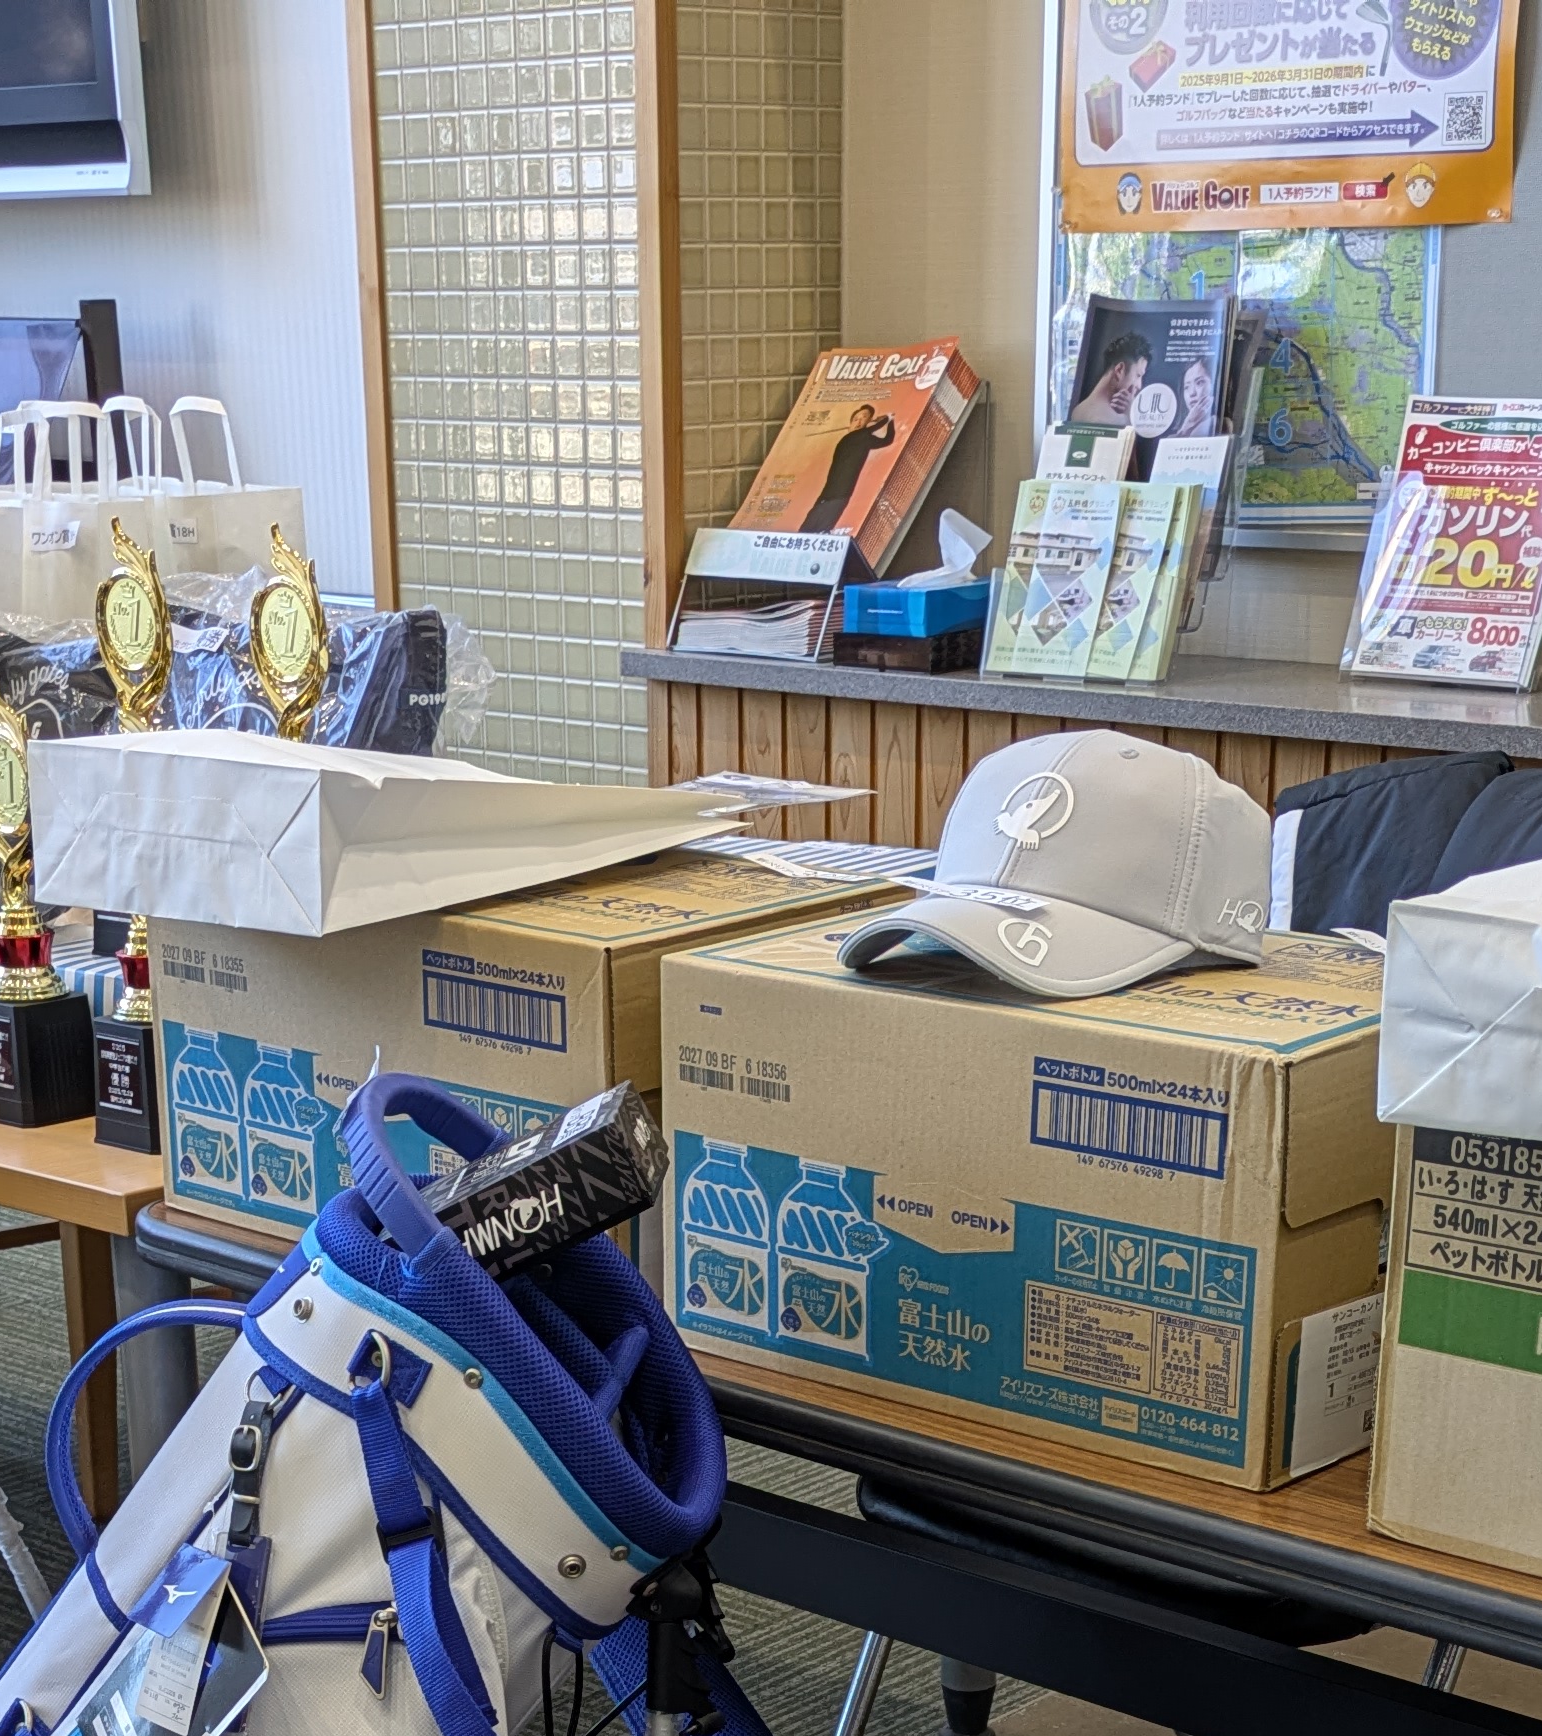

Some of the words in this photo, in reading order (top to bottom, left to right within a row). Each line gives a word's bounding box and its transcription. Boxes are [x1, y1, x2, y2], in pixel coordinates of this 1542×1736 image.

[1185, 26, 1376, 68] プレゼントが当たる
[1411, 38, 1452, 61] もらえる
[1150, 182, 1200, 212] VALUE
[1202, 180, 1251, 210] GOLF
[1267, 185, 1335, 201] 1人予約ランド
[826, 354, 880, 382] VALUE
[880, 353, 928, 380] GOLF
[1269, 338, 1293, 374] 4
[1269, 408, 1293, 446] 6
[753, 534, 844, 552] ご自由にお持ちください
[1414, 629, 1463, 640] カーリース
[162, 943, 180, 960] 2027
[194, 950, 206, 966] BF
[220, 955, 244, 974] 18355
[425, 952, 473, 972] ペットボトル
[678, 1045, 703, 1066] 2027
[705, 1049, 719, 1069] 09
[720, 1052, 737, 1072] BF
[755, 1059, 788, 1082] 18356
[1038, 1060, 1101, 1084] ペットボトル
[331, 1075, 359, 1092] OPEN
[1076, 1153, 1095, 1167] 149
[1098, 1157, 1129, 1174] 67576
[1133, 1163, 1164, 1180] 49298
[1417, 1164, 1513, 1205] い・ろ・は・す
[897, 1199, 934, 1219] OPEN
[951, 1210, 989, 1230] OPEN
[897, 1298, 991, 1345] 富士山の
[897, 1330, 972, 1372] 天然水
[999, 1375, 1100, 1413] アイリスフーズ株式会社
[1140, 1406, 1240, 1442] 0120-464-812
